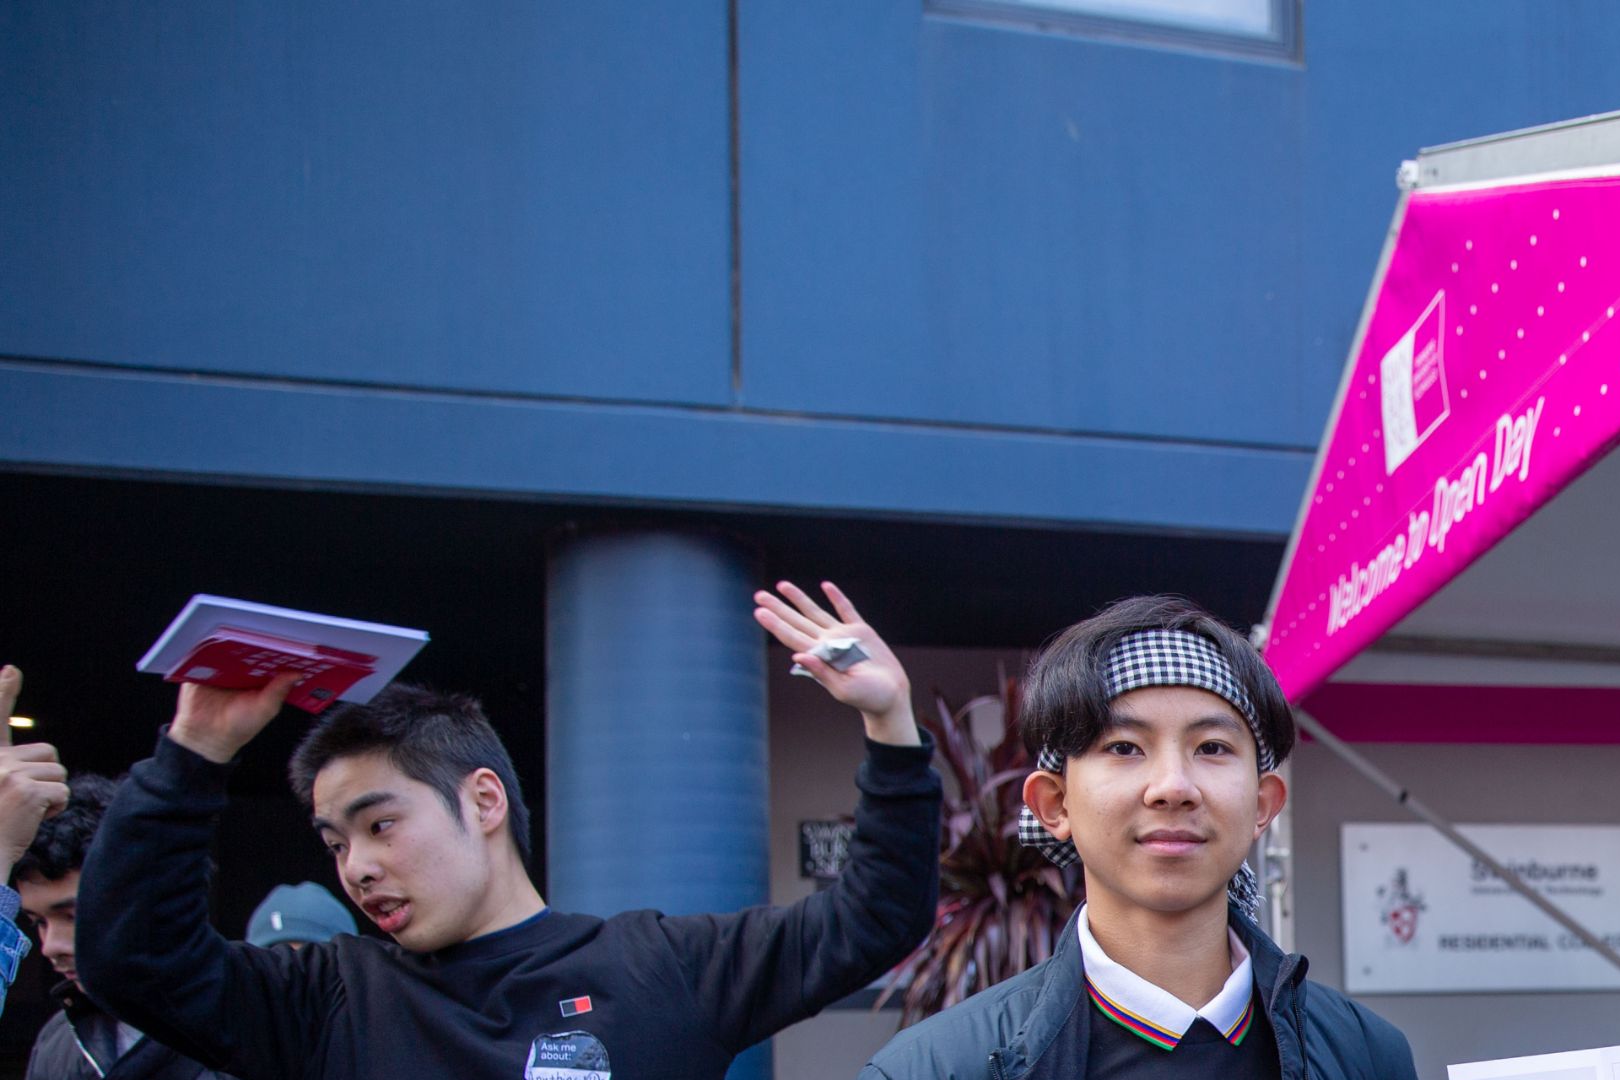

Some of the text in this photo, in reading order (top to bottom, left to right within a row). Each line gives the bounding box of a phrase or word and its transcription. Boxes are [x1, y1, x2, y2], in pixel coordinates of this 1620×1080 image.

[1327, 395, 1546, 637] Welcome to Open Day
[1438, 933, 1549, 951] RESIDENTIAL
[541, 1042, 577, 1052] Ask me
[540, 1051, 573, 1061] about:
